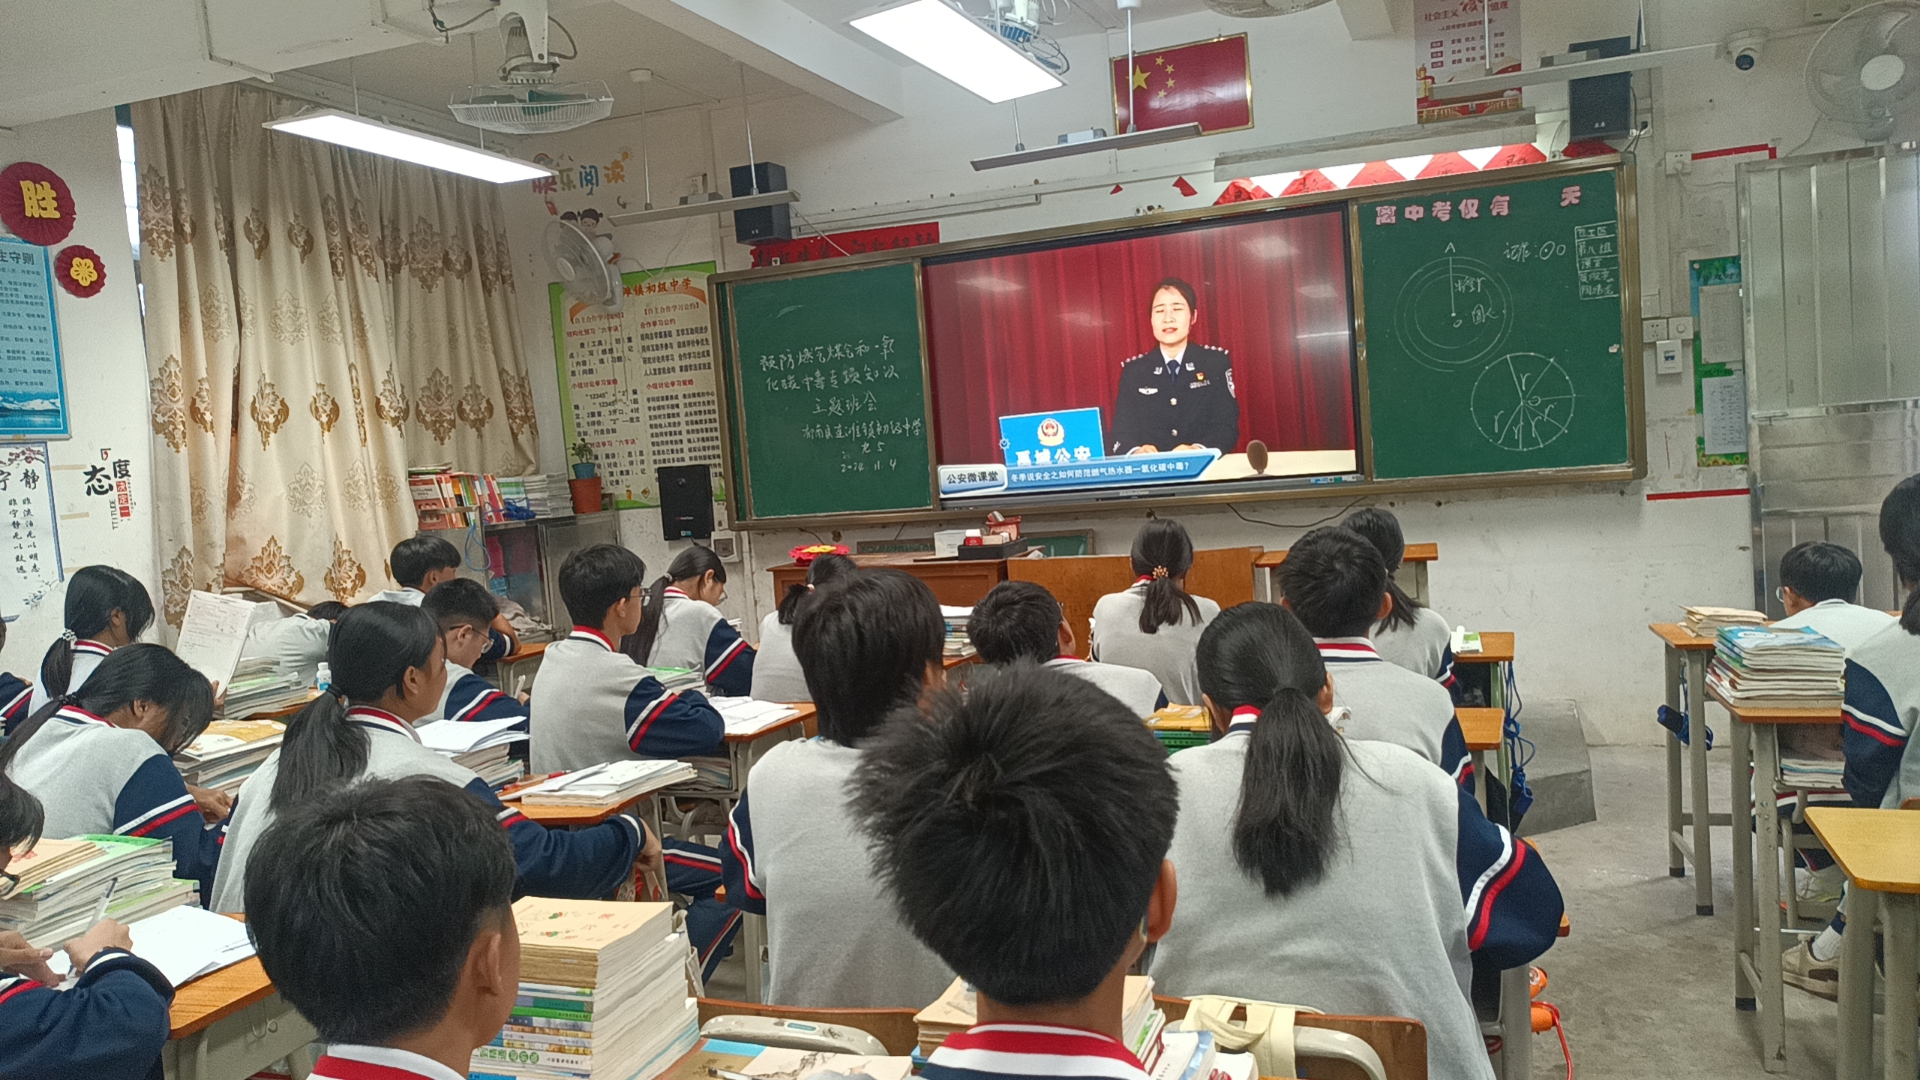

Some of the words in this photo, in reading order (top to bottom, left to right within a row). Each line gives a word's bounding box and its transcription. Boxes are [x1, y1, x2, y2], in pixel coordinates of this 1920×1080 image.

[532, 158, 625, 195] 快乐阅读
[19, 180, 61, 219] 胜
[1375, 194, 1511, 226] 离中考仅有
[1560, 185, 1582, 207] 天
[1444, 242, 1456, 254] A
[812, 389, 878, 416] 主题班会
[83, 459, 132, 497] 态度
[946, 470, 999, 486] 公安微课堂
